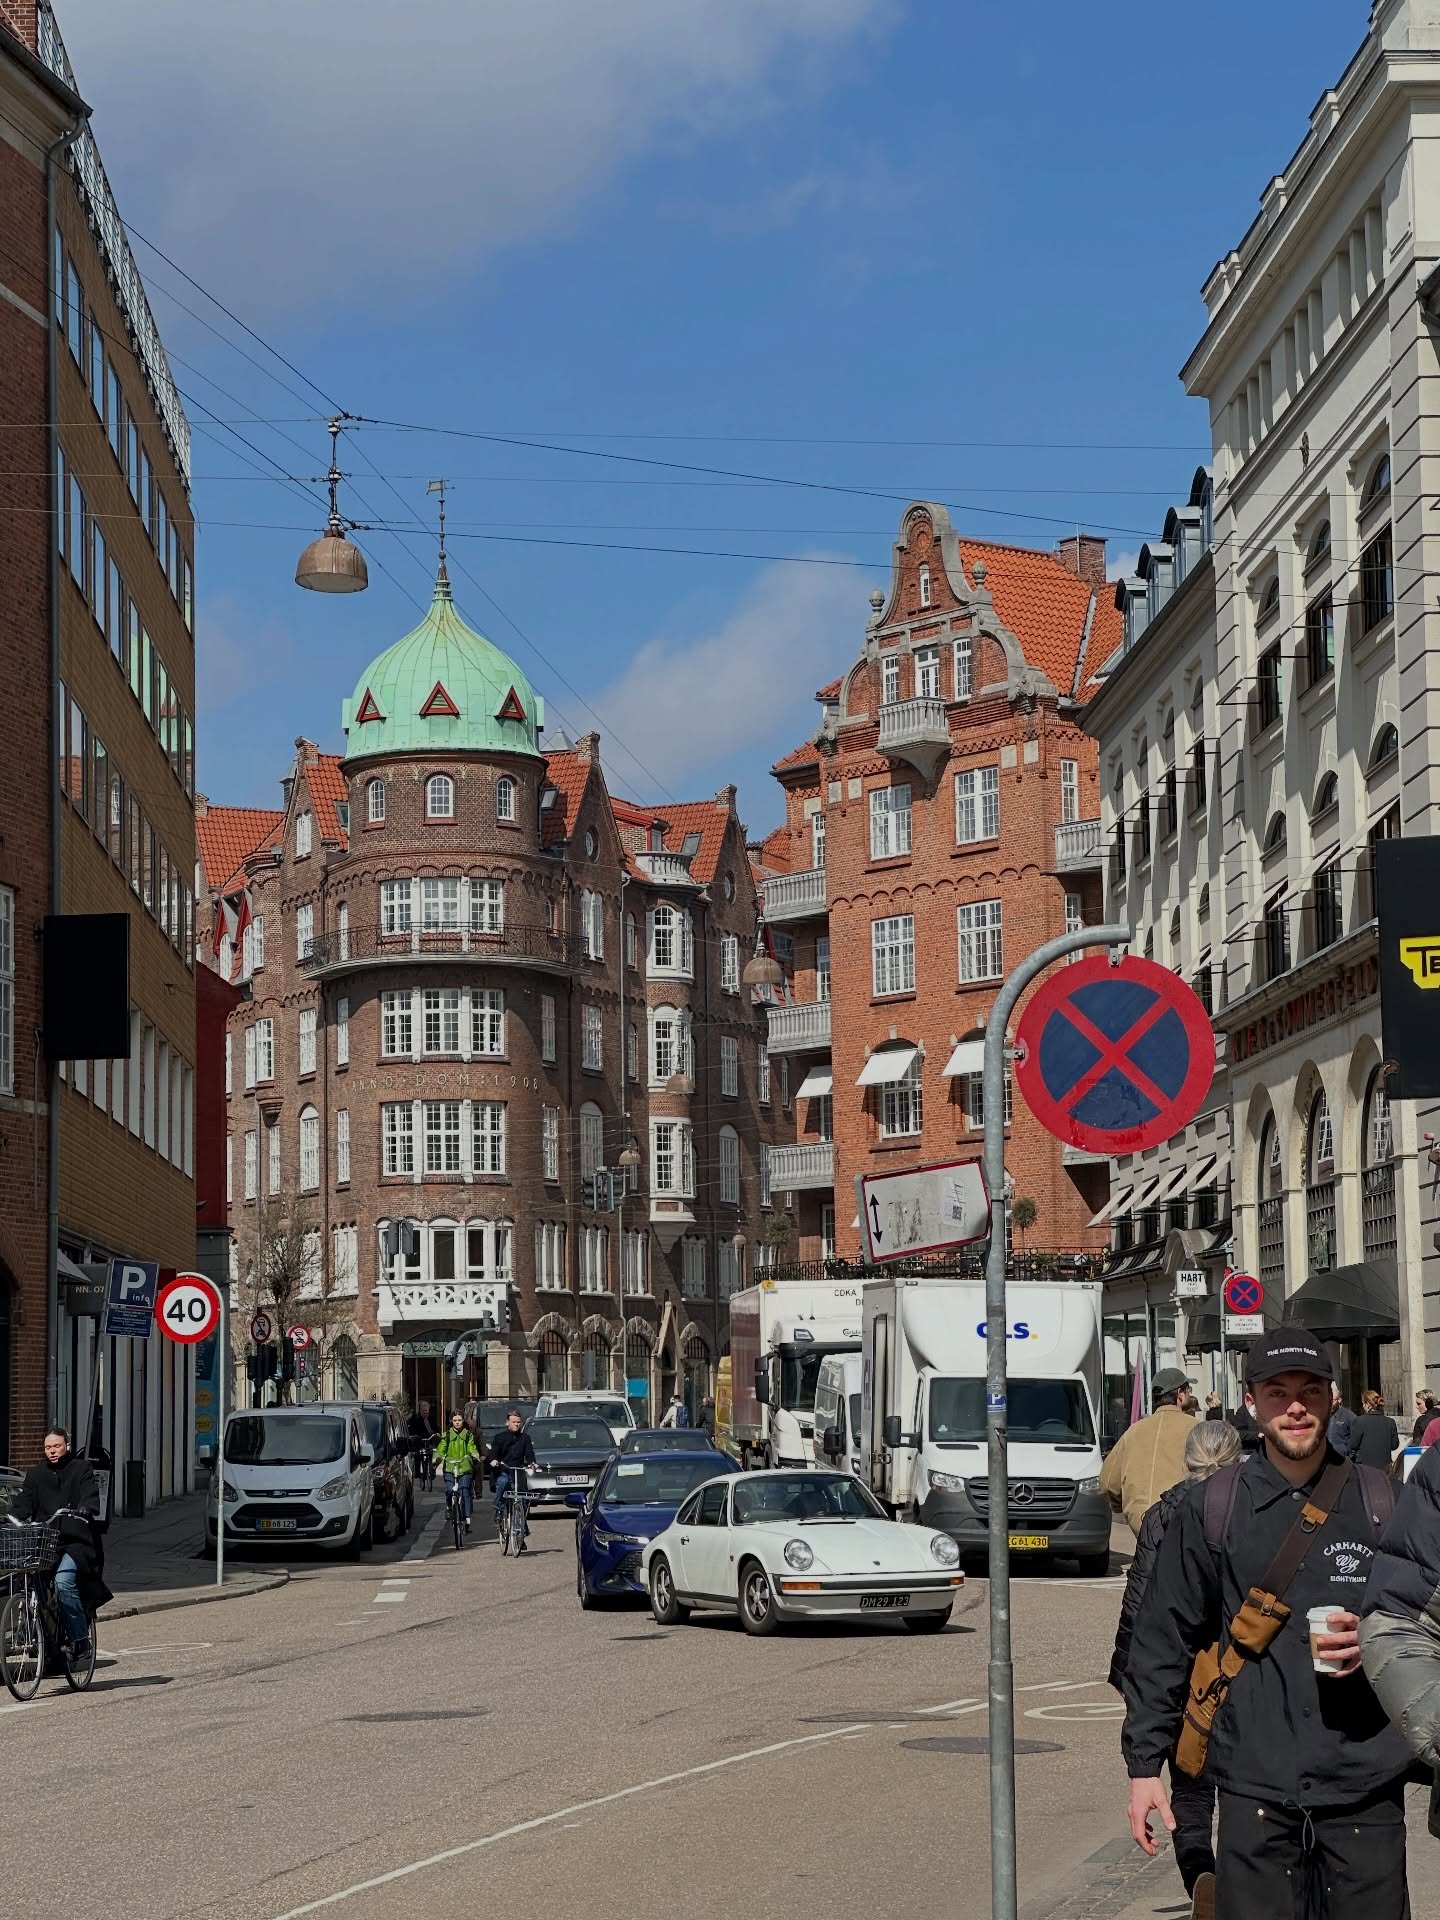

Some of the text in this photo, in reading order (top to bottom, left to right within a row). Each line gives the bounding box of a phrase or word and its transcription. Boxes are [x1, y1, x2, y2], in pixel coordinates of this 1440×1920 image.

[495, 1075, 538, 1090] 1908
[120, 1266, 147, 1300] P
[1181, 1273, 1203, 1282] HART
[132, 1293, 150, 1303] info
[166, 1298, 206, 1322] 40
[1267, 1349, 1279, 1357] THE
[1019, 1538, 1028, 1546] 61
[1031, 1538, 1047, 1546] 430
[1323, 1541, 1374, 1558] CARHARTT
